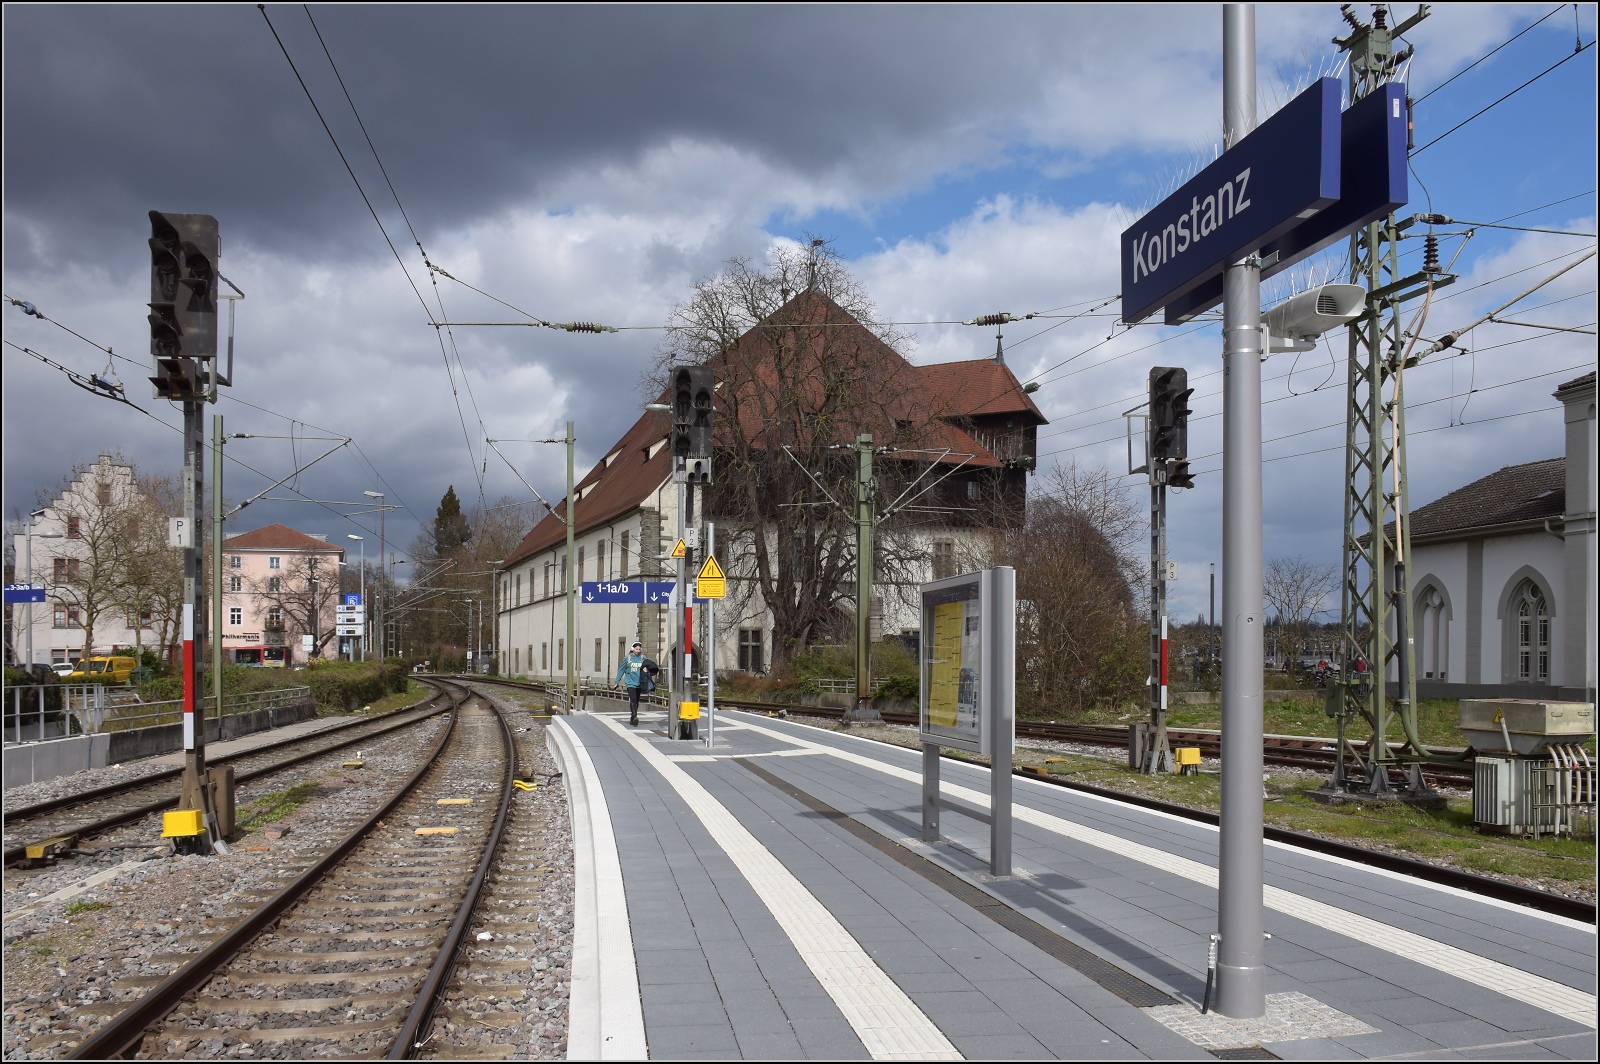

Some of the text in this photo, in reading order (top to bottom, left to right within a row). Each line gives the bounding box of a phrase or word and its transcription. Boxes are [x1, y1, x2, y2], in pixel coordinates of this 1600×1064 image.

[1132, 167, 1251, 284] Konstanz
[176, 520, 184, 531] P
[689, 529, 695, 537] P
[177, 533, 182, 545] 1
[689, 538, 694, 546] 2
[1169, 571, 1175, 579] 3
[596, 583, 629, 593] 1-1a/b
